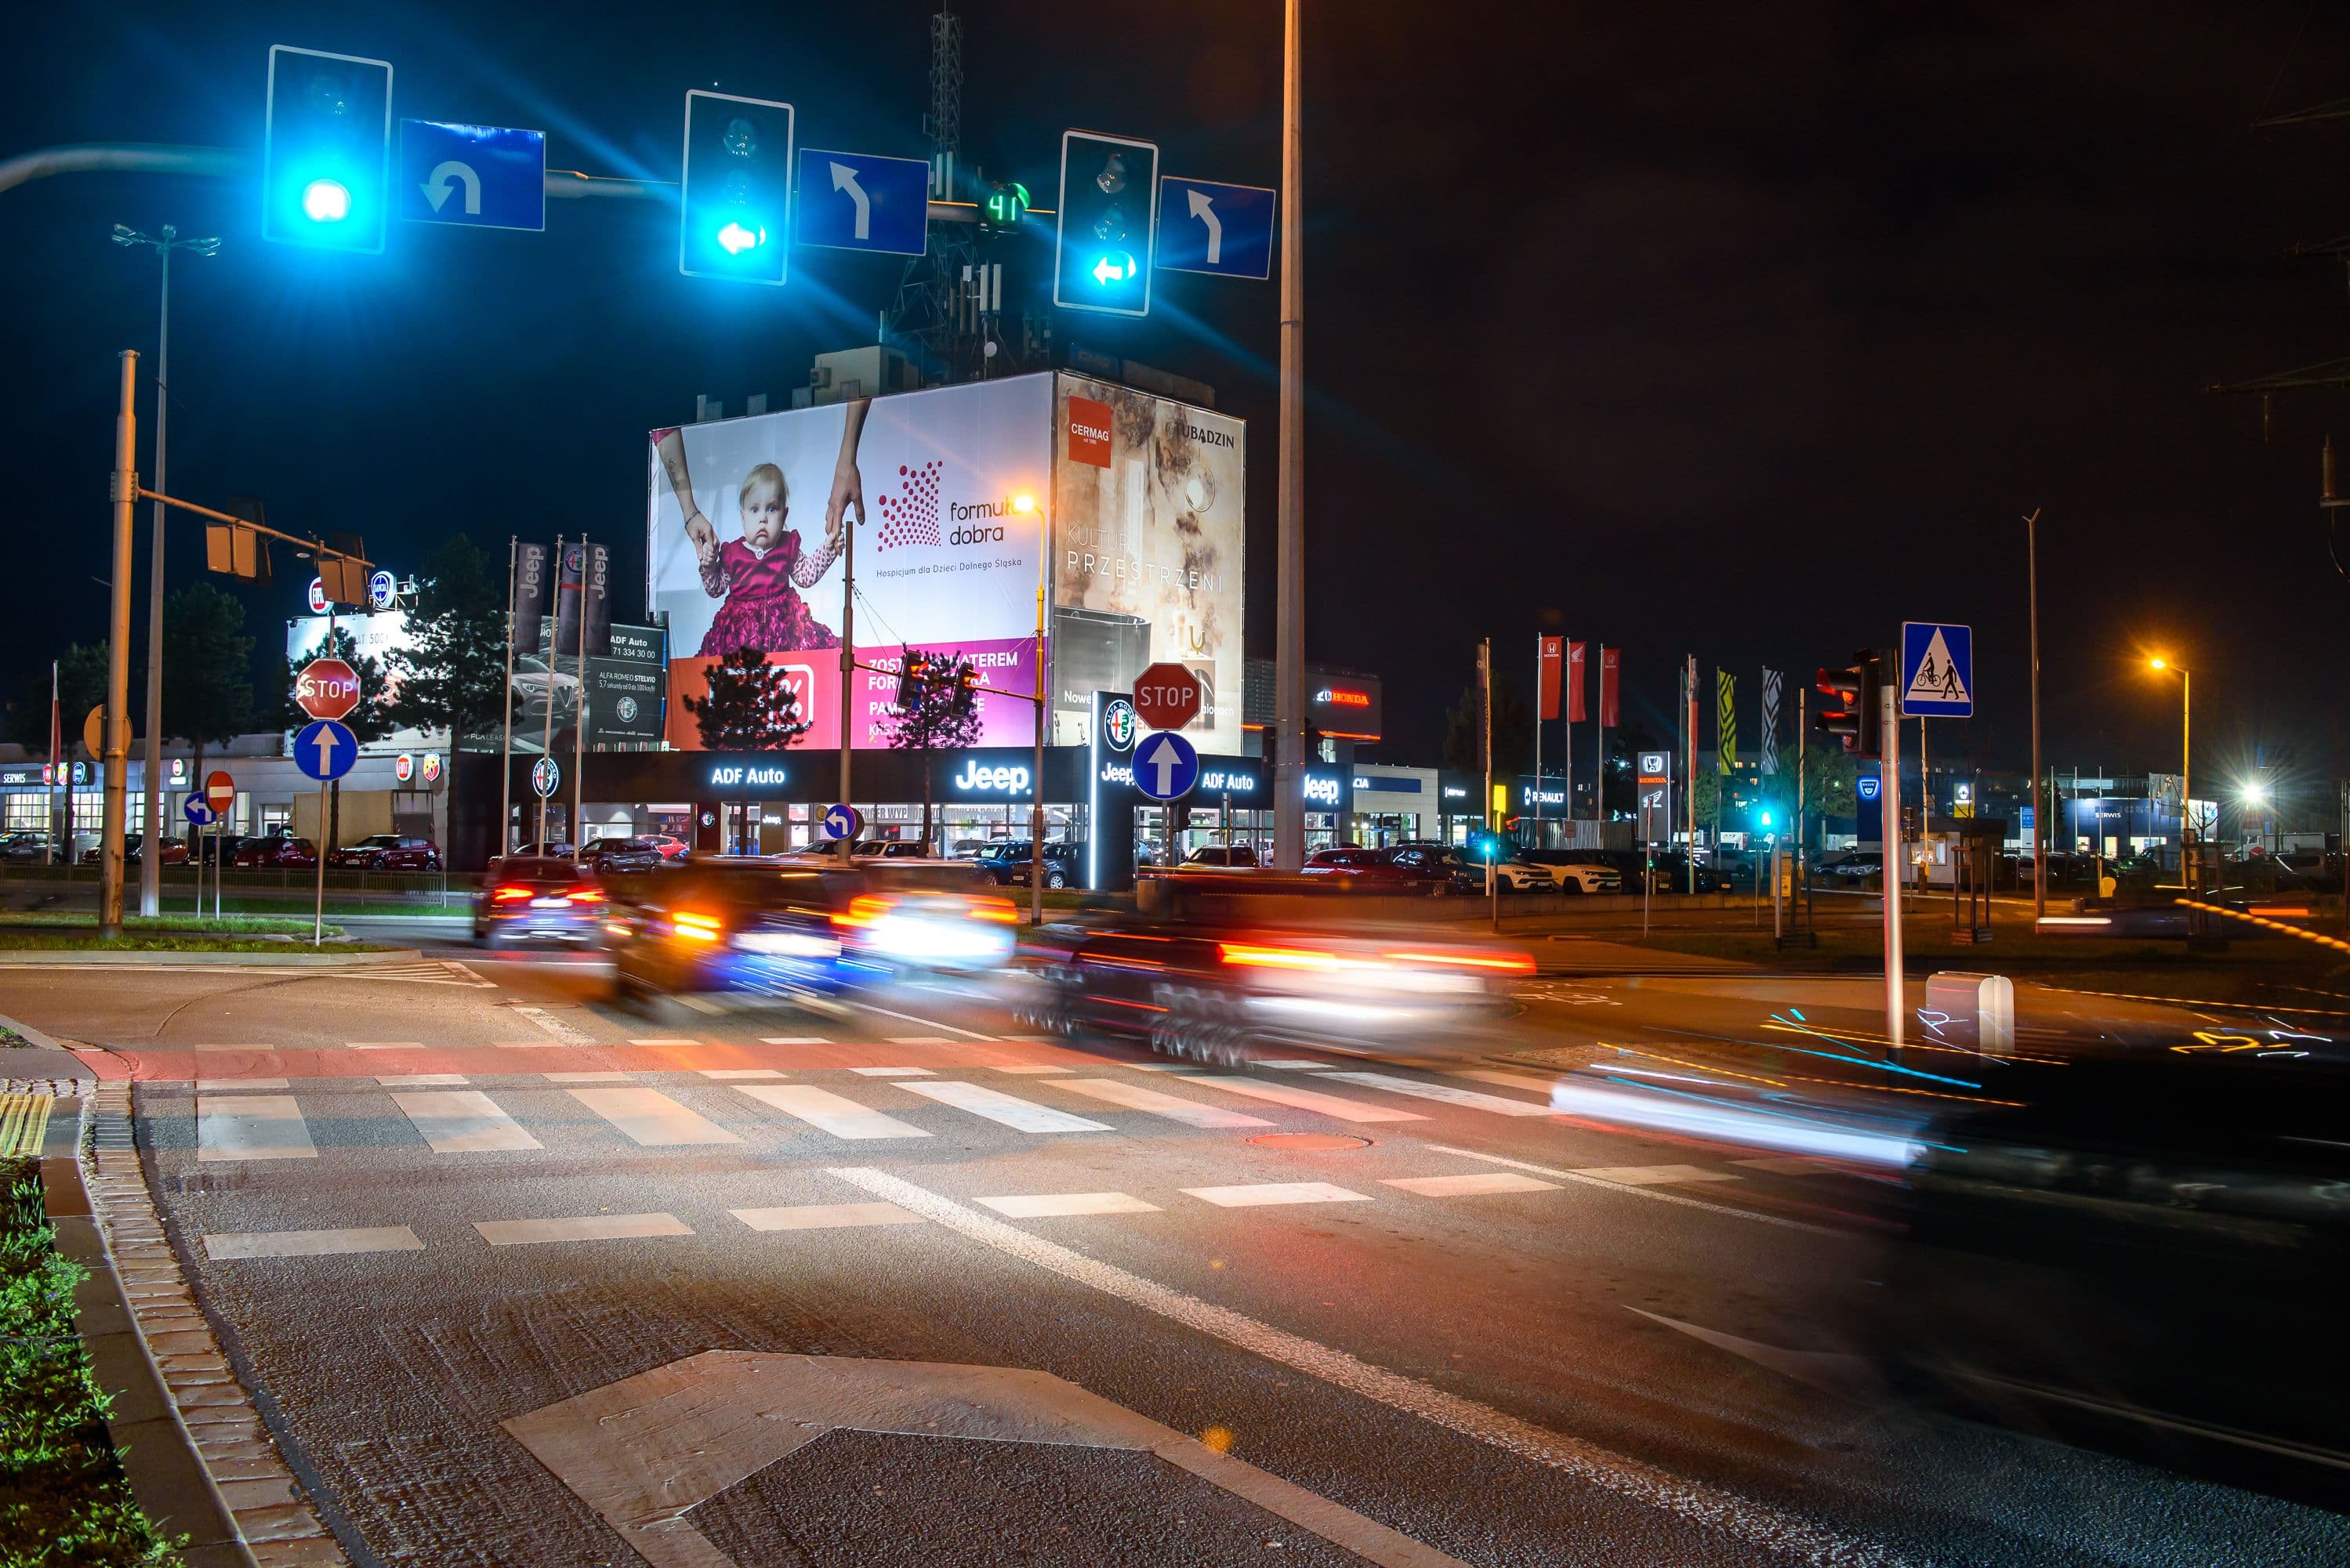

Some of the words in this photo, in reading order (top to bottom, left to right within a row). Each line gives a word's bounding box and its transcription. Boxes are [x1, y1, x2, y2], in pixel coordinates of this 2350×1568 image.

[1071, 423, 1109, 441] CERMAG
[949, 524, 1004, 545] dobra
[520, 547, 544, 598] Jeep
[589, 547, 608, 599] Jeep
[876, 565, 916, 578] Hospicjum
[918, 566, 930, 574] dla
[933, 563, 957, 573] Dzieci
[959, 561, 992, 571] Dolnego
[995, 557, 1022, 569] Śląska
[1068, 551, 1224, 594] PRZESTRZENI
[610, 635, 627, 644] ADF
[628, 637, 647, 646] Auto
[613, 646, 621, 655] 71
[622, 648, 635, 657] 334
[636, 650, 646, 658] 30
[647, 650, 655, 659] 00
[634, 675, 656, 683] STELVIO
[305, 680, 354, 699] STOP
[1064, 690, 1092, 704] Nowe
[1141, 686, 1194, 707] STOP
[1333, 692, 1369, 705] HONDA
[1107, 704, 1118, 726] ALFA
[486, 734, 516, 743] LEASIG
[3, 773, 26, 784] SERWIS
[713, 768, 742, 784] ADF
[747, 768, 785, 784] Auto
[956, 760, 1032, 795] Jeep
[1101, 762, 1135, 786] Jeep
[1202, 773, 1224, 788] ADF
[1227, 774, 1253, 790] Auto
[1532, 791, 1565, 803] RENAULT
[762, 815, 782, 825] Jeep
